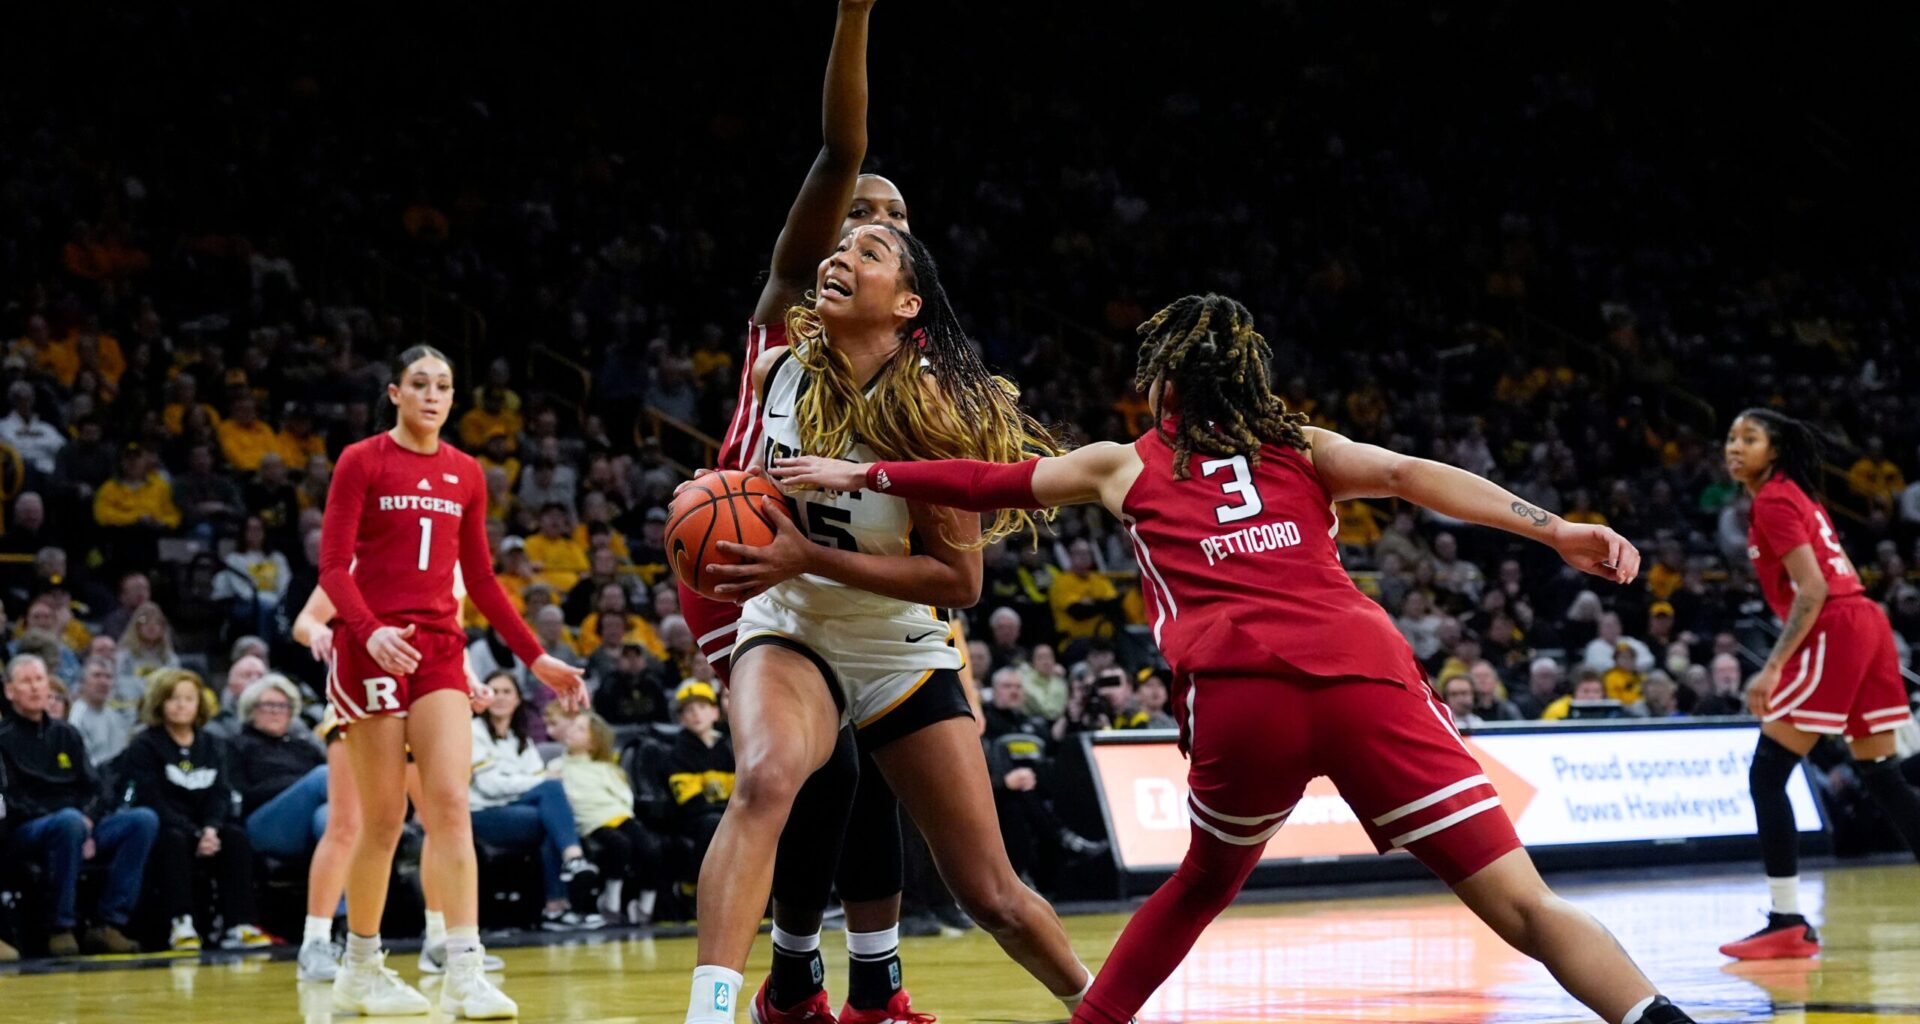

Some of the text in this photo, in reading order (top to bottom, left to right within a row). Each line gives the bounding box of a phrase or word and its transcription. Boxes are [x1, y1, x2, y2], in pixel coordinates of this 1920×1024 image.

[379, 495, 462, 517] RUTGERS
[1200, 454, 1263, 525] 3
[418, 516, 433, 571] 1
[1199, 521, 1301, 567] PETTICORD
[362, 676, 401, 712] R
[1551, 753, 1622, 780] Proud
[1627, 758, 1711, 785] sponsor
[1717, 750, 1738, 775] of
[1564, 794, 1623, 822] Iowa
